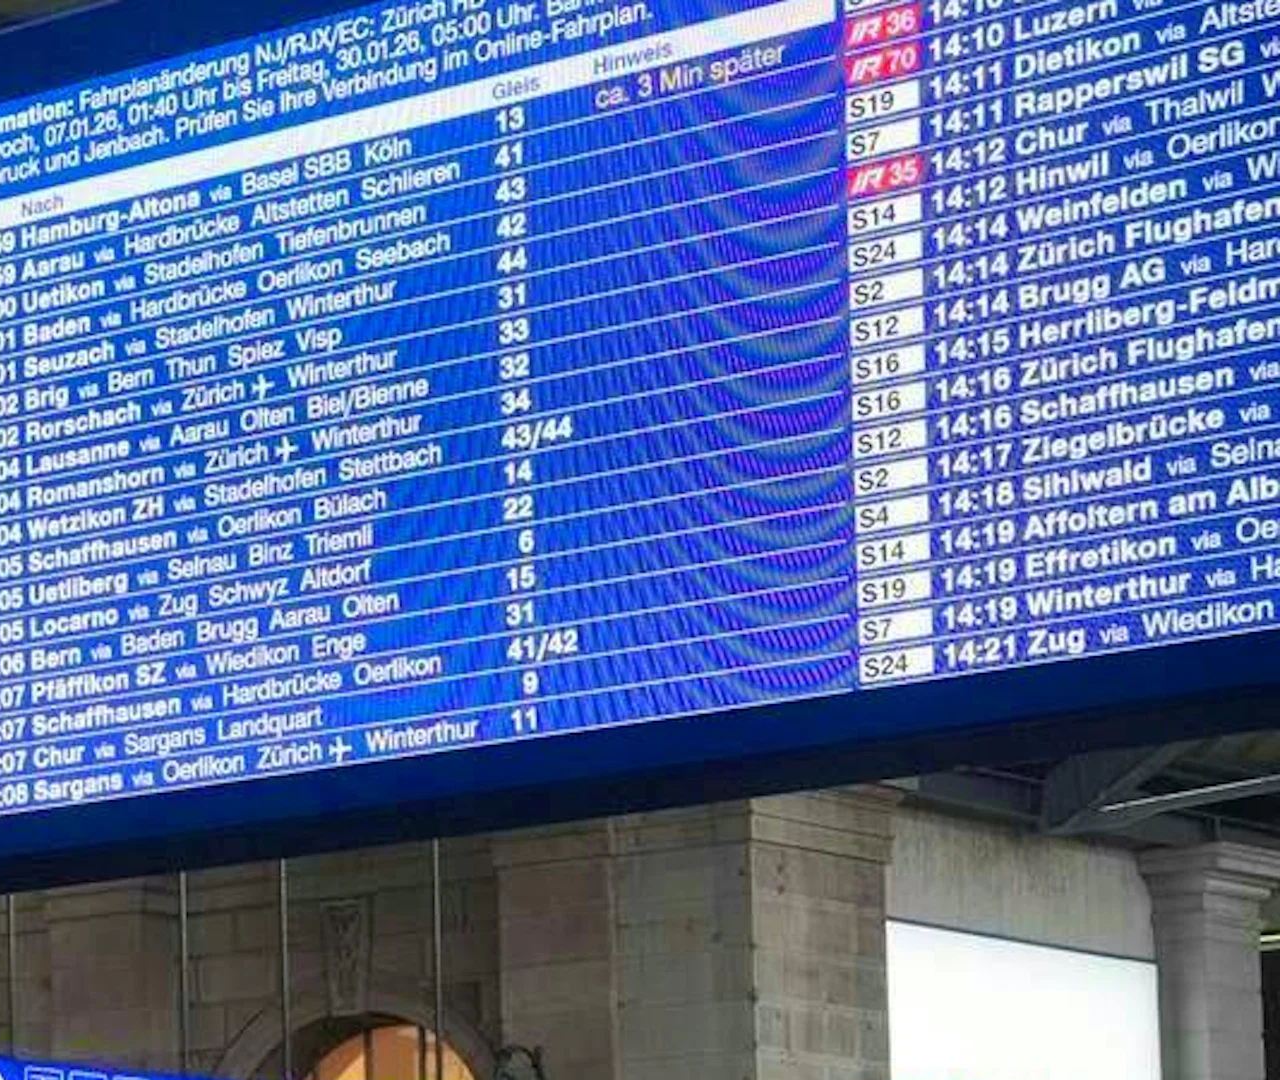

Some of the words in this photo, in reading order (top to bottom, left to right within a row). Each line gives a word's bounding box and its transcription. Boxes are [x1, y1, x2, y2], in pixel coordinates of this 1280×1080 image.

[886, 6, 916, 33] 36
[889, 43, 915, 70] 70
[929, 23, 1005, 61] 14:10
[1013, 0, 1117, 42] Luzern
[79, 52, 249, 110] Fahrplanänderung
[127, 93, 178, 125] 01:40
[182, 86, 217, 110] Uhr
[222, 72, 252, 101] bis
[850, 90, 894, 118] S19
[928, 60, 1002, 99] 14:11
[1014, 32, 1140, 80] Dietikon
[851, 130, 879, 156] S7
[930, 98, 1002, 138] 14:11
[1014, 52, 1188, 118] Rapperswil
[1198, 40, 1244, 73] SG
[20, 191, 64, 218] Nach
[492, 72, 541, 103] Gleis
[44, 145, 79, 172] und
[175, 109, 237, 137] Prüfen
[242, 97, 274, 121] Sie
[495, 106, 524, 132] 13
[889, 156, 916, 184] 35
[930, 137, 1005, 175] 14:12
[1015, 122, 1088, 155] Chur
[1144, 79, 1243, 125] Thalwil
[494, 142, 522, 167] 41
[495, 176, 525, 202] 43
[852, 203, 896, 230] S14
[931, 175, 1007, 212] 14:12
[1015, 151, 1108, 195] Hinwil
[497, 212, 526, 237] 42
[853, 240, 896, 267] S24
[932, 213, 1008, 251] 14:14
[1015, 179, 1186, 232] Weinfelden
[497, 246, 527, 273] 44
[854, 280, 883, 305] S2
[932, 251, 1009, 288] 14:14
[1017, 230, 1114, 272] Zürich
[499, 282, 525, 309] 31
[855, 315, 898, 342] S12
[934, 289, 1009, 326] 14:14
[1018, 274, 1110, 310] Brugg
[1119, 257, 1165, 288] AG
[499, 318, 529, 344] 33
[856, 352, 899, 379] S16
[934, 327, 1010, 364] 14:15
[500, 353, 529, 379] 32
[857, 390, 900, 417] S16
[935, 366, 1011, 402] 14:16
[1019, 347, 1117, 387] Zürich
[501, 388, 531, 414] 34
[858, 427, 901, 454] S12
[936, 404, 1012, 440] 14:16
[1020, 367, 1233, 425] Schaffhausen
[502, 415, 572, 449] 43/44
[859, 467, 888, 491] S2
[937, 442, 1012, 478] 14:17
[1021, 408, 1224, 464] Ziegelbrücke
[504, 459, 532, 485] 14
[860, 505, 888, 528] S4
[938, 481, 1014, 515] 14:18
[1022, 456, 1151, 501] Sihlwald
[504, 494, 532, 520] 22
[861, 540, 904, 566] S14
[940, 519, 1015, 553] 14:19
[1022, 499, 1158, 541] Affoltern
[1169, 490, 1216, 515] am
[519, 529, 534, 553] 6
[507, 565, 535, 590] 15
[862, 578, 906, 603] S19
[940, 557, 1016, 591] 14:19
[1025, 536, 1175, 579] Effretikon
[506, 601, 533, 626] 31
[863, 617, 892, 641] S7
[942, 596, 1017, 629] 14:19
[1025, 573, 1191, 616] Winterthur
[507, 629, 577, 660] 41/42
[864, 653, 907, 678] S24
[943, 634, 1015, 667] 14:21
[1027, 628, 1085, 655] Zug
[1141, 600, 1273, 637] Wiedikon
[523, 671, 538, 694] 9
[511, 706, 536, 731] 11
